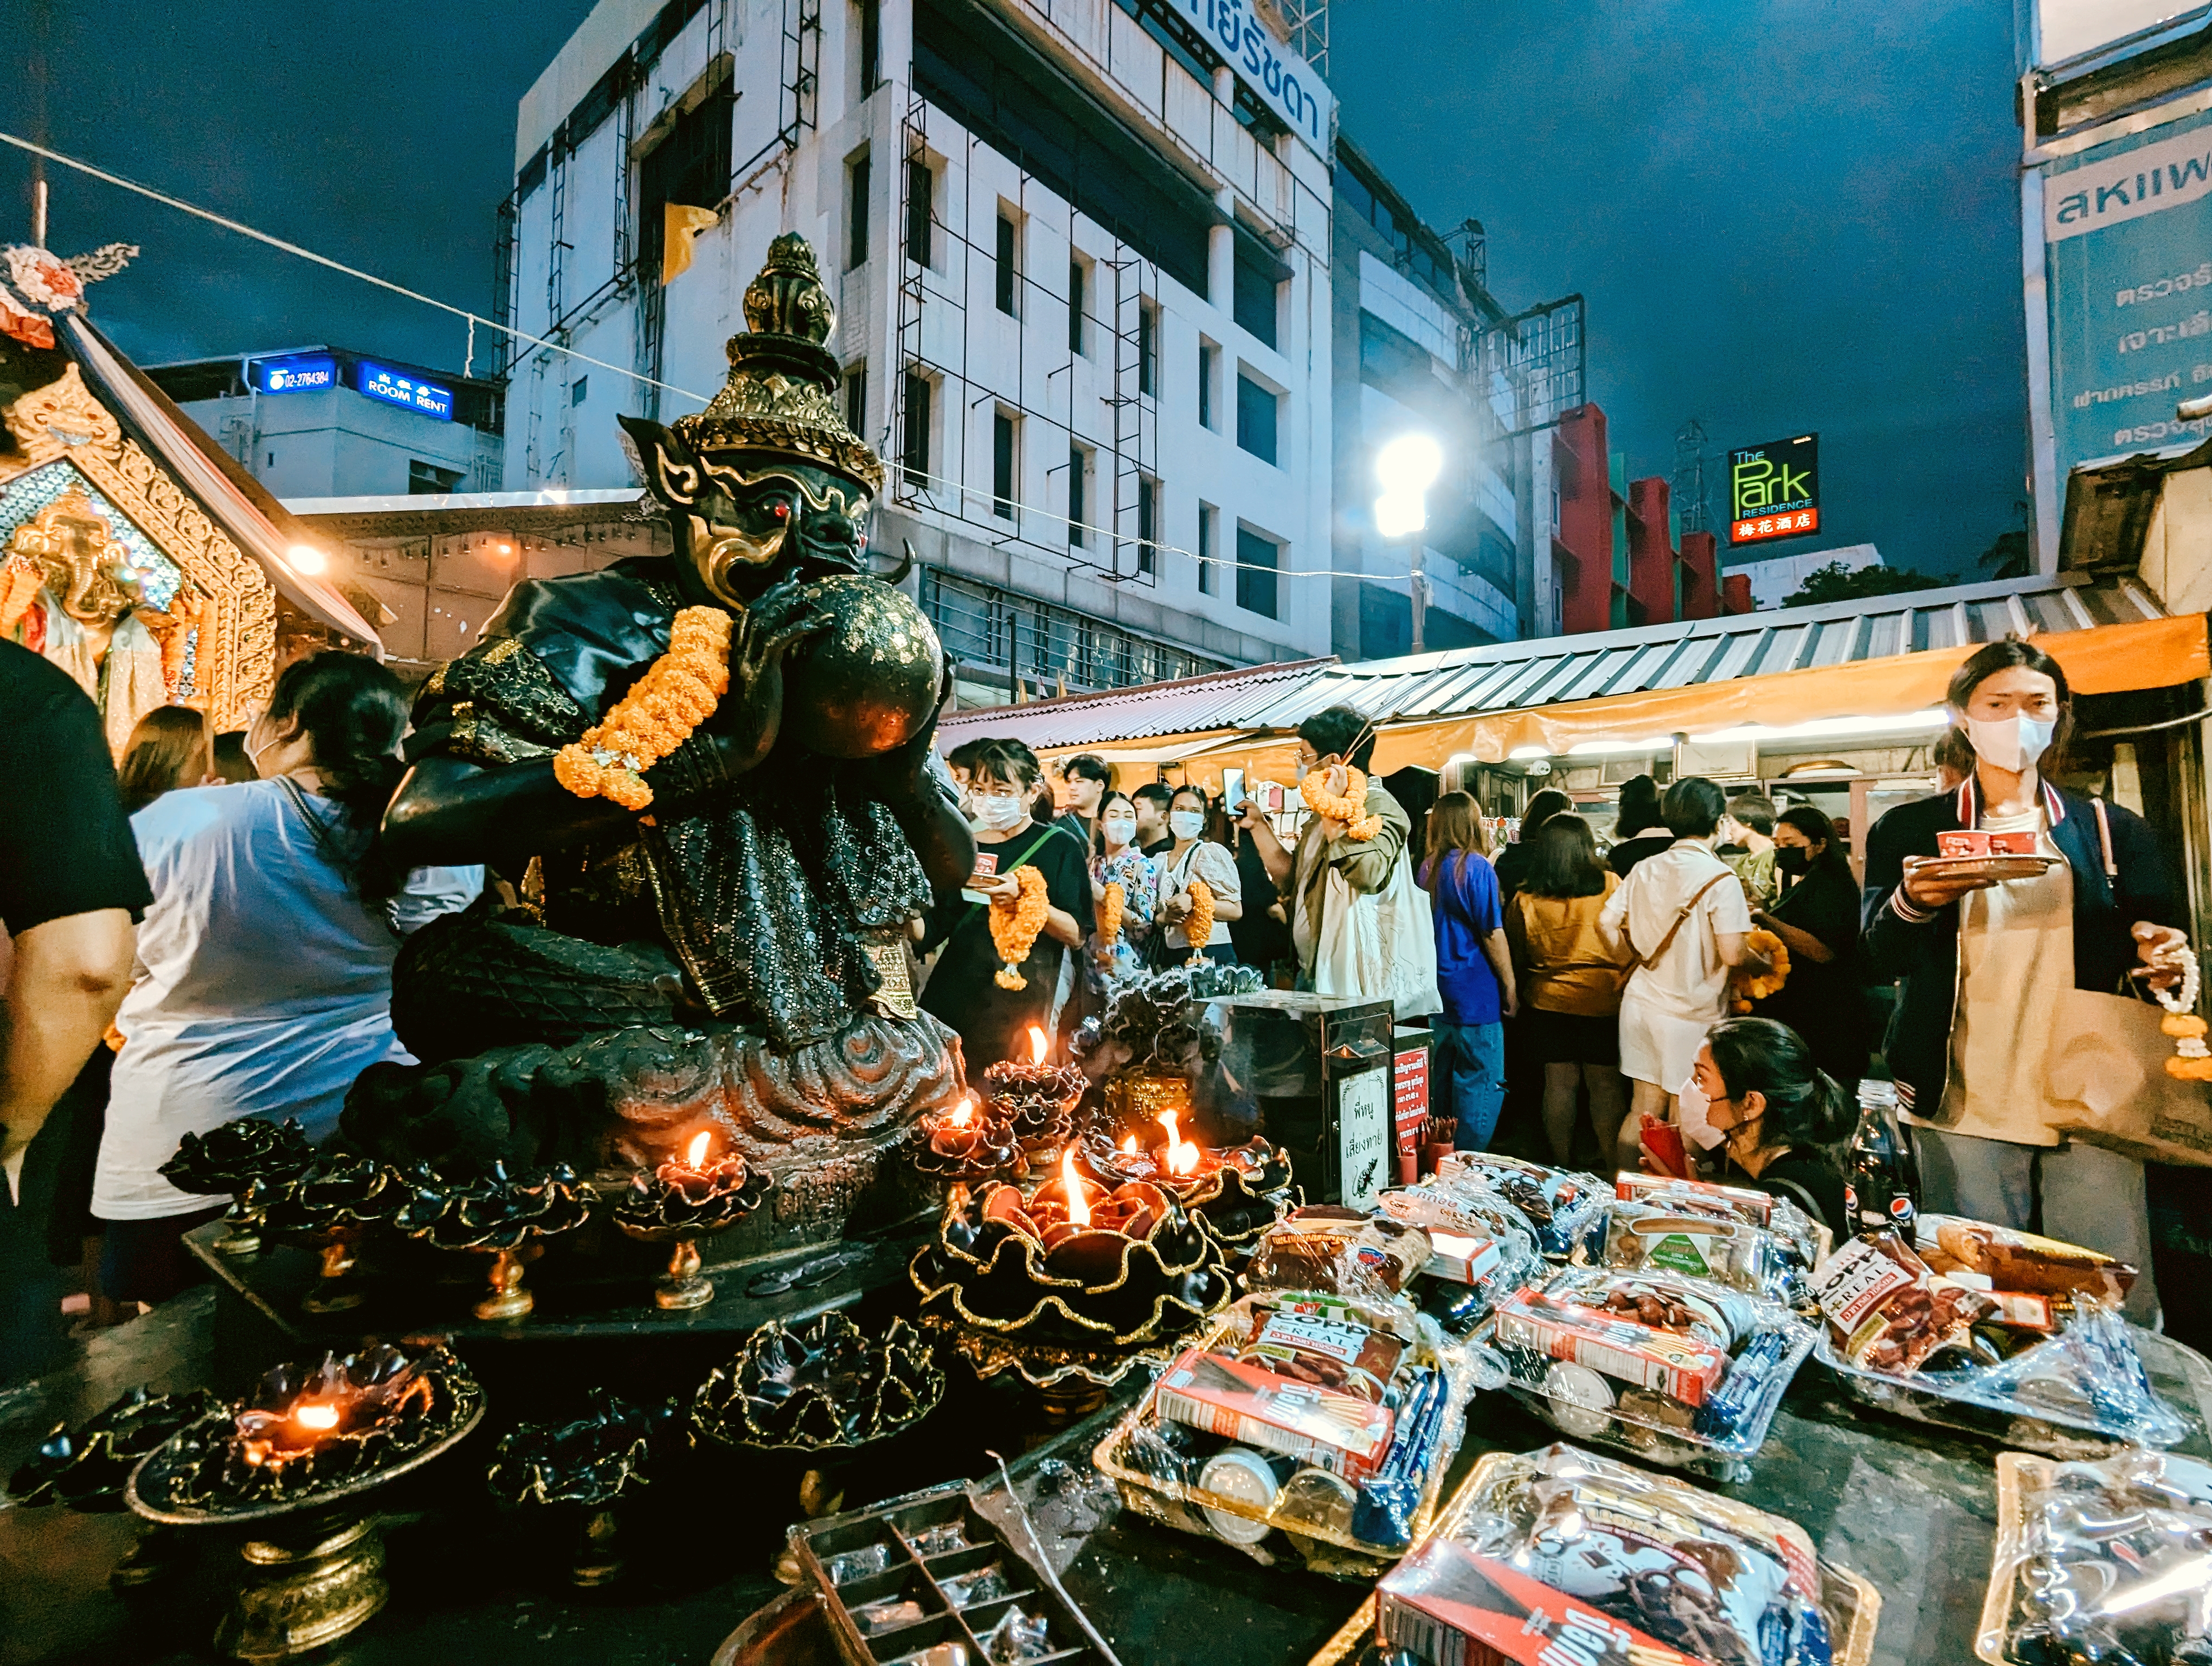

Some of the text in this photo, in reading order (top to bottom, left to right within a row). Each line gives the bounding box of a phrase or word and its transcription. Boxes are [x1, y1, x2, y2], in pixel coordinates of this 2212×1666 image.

[369, 380, 411, 402] ROOM
[416, 395, 447, 414] RENT
[1734, 451, 1765, 465] The
[1734, 459, 1811, 521] Park
[1742, 498, 1814, 519] RESIDENCE
[1738, 513, 1811, 537] 梅花酒店
[1265, 1323, 1365, 1354] CEREALS
